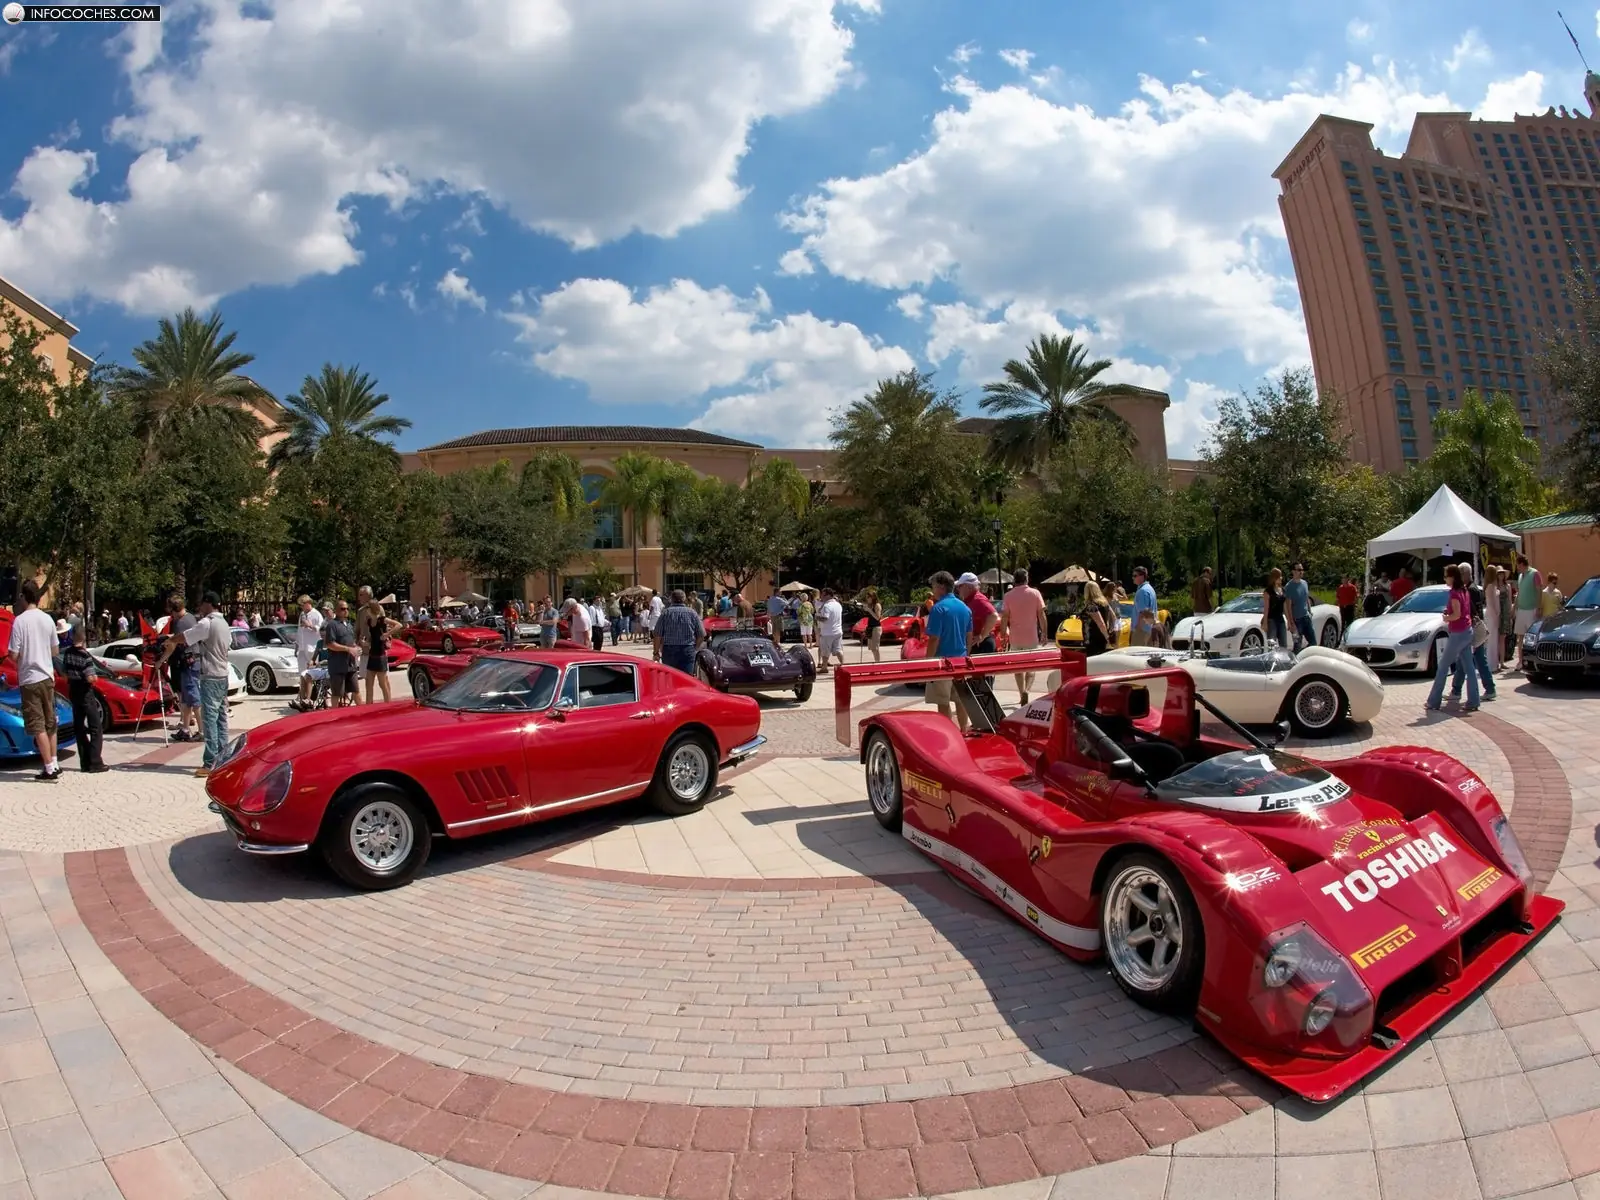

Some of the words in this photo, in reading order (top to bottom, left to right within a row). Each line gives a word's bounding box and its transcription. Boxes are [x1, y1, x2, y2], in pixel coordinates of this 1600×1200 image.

[1025, 705, 1047, 721] Lease
[1242, 753, 1277, 772] 7
[904, 769, 942, 799] PIRELLI
[1259, 793, 1325, 811] Lease
[1357, 842, 1386, 860] racing
[1384, 832, 1407, 846] team
[1320, 831, 1457, 912] TOSHIBA
[1457, 866, 1503, 901] PIRELLI
[1350, 924, 1417, 969] PIRELLI
